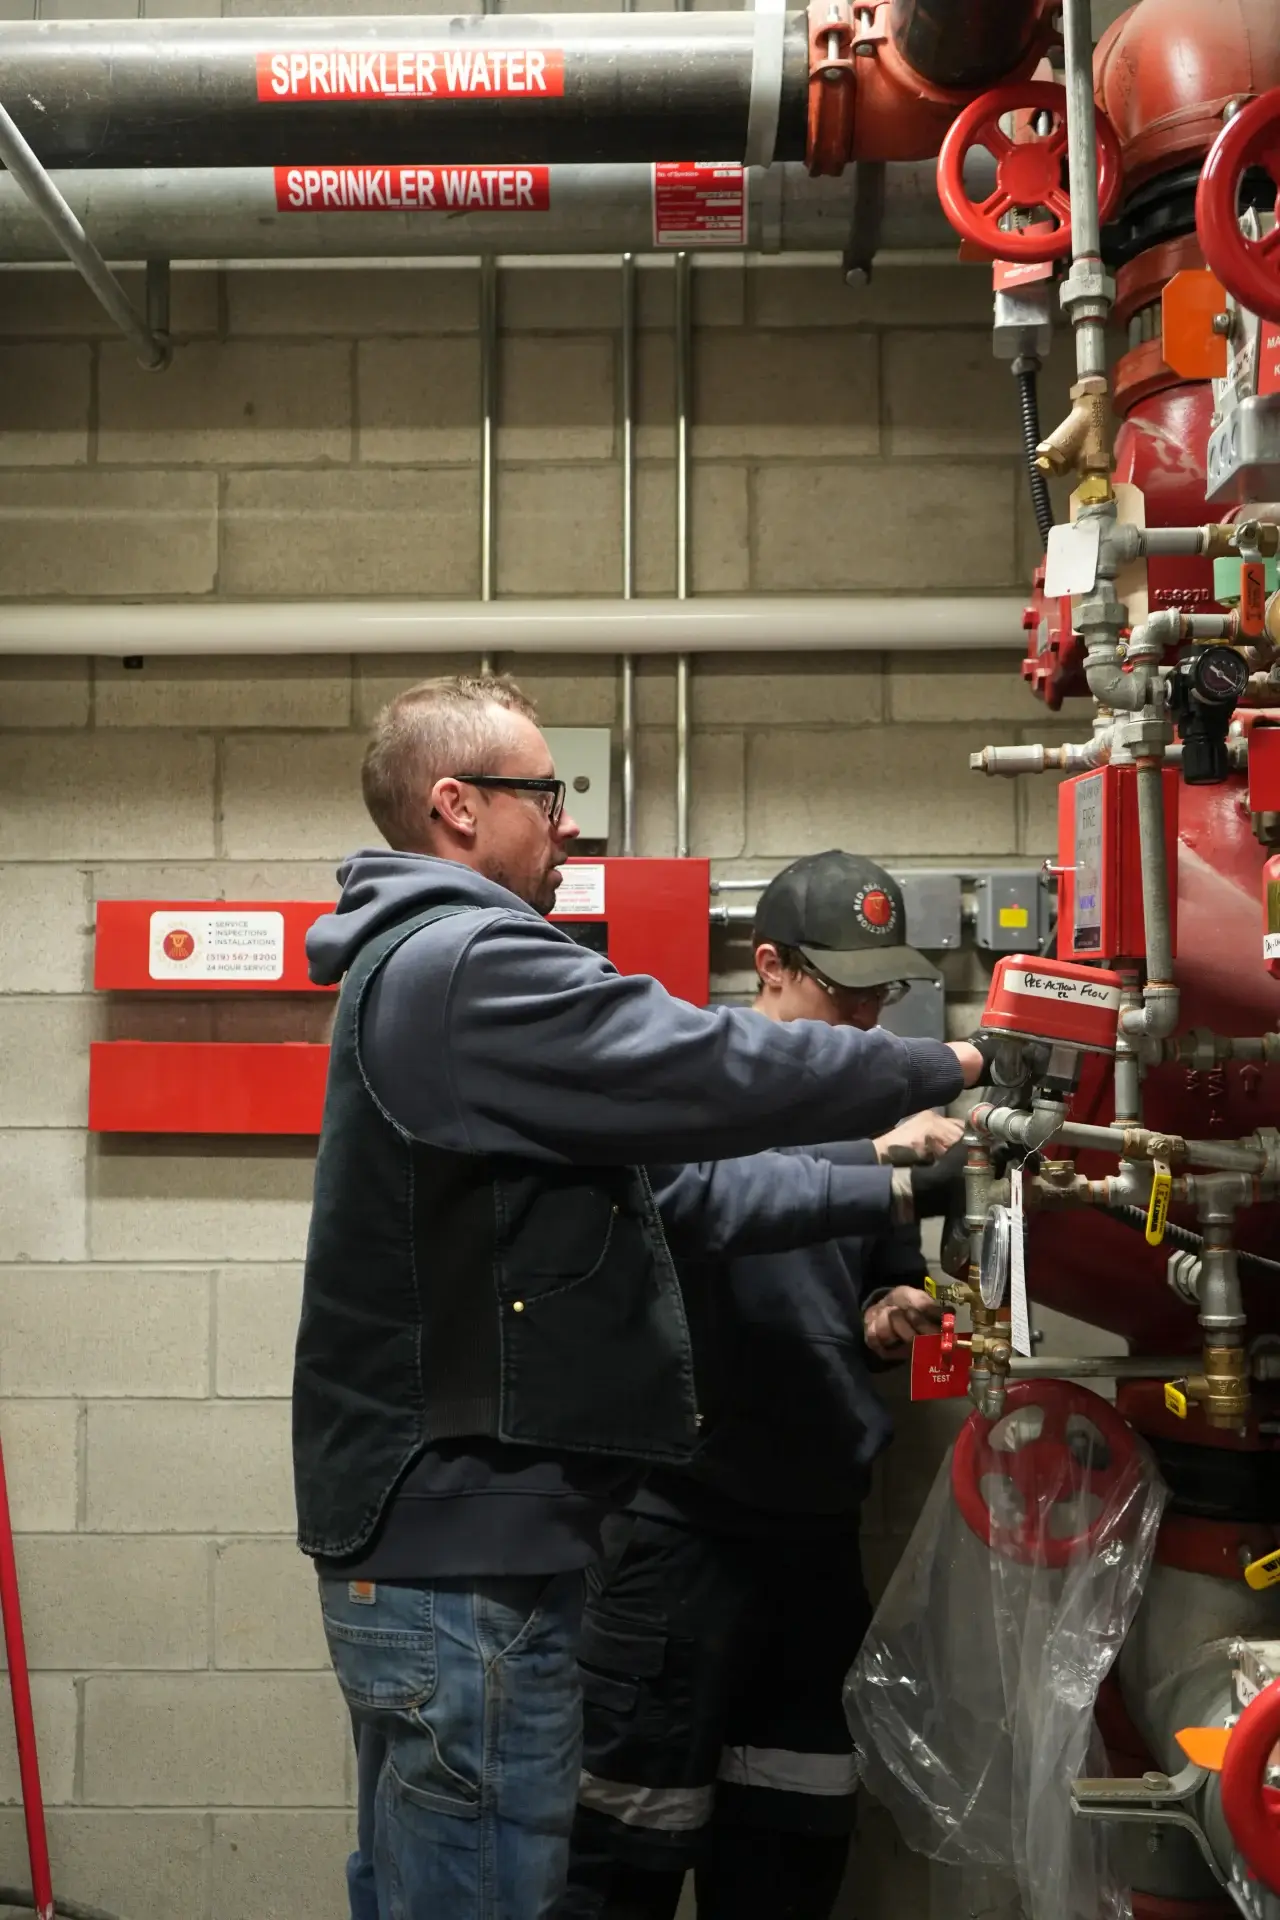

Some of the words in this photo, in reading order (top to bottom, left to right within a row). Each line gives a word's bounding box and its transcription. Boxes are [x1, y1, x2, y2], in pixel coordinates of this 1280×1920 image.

[271, 51, 437, 95] SPRINKLER
[443, 50, 547, 92] WATER
[287, 169, 436, 207] SPRINKLER
[441, 170, 534, 206] WATER
[215, 929, 267, 937] INSPECTIONS
[214, 938, 276, 946] INSTALLATIONS
[1080, 983, 1109, 1000] FLOW
[928, 1364, 955, 1374] ALM
[932, 1374, 951, 1383] TEST
